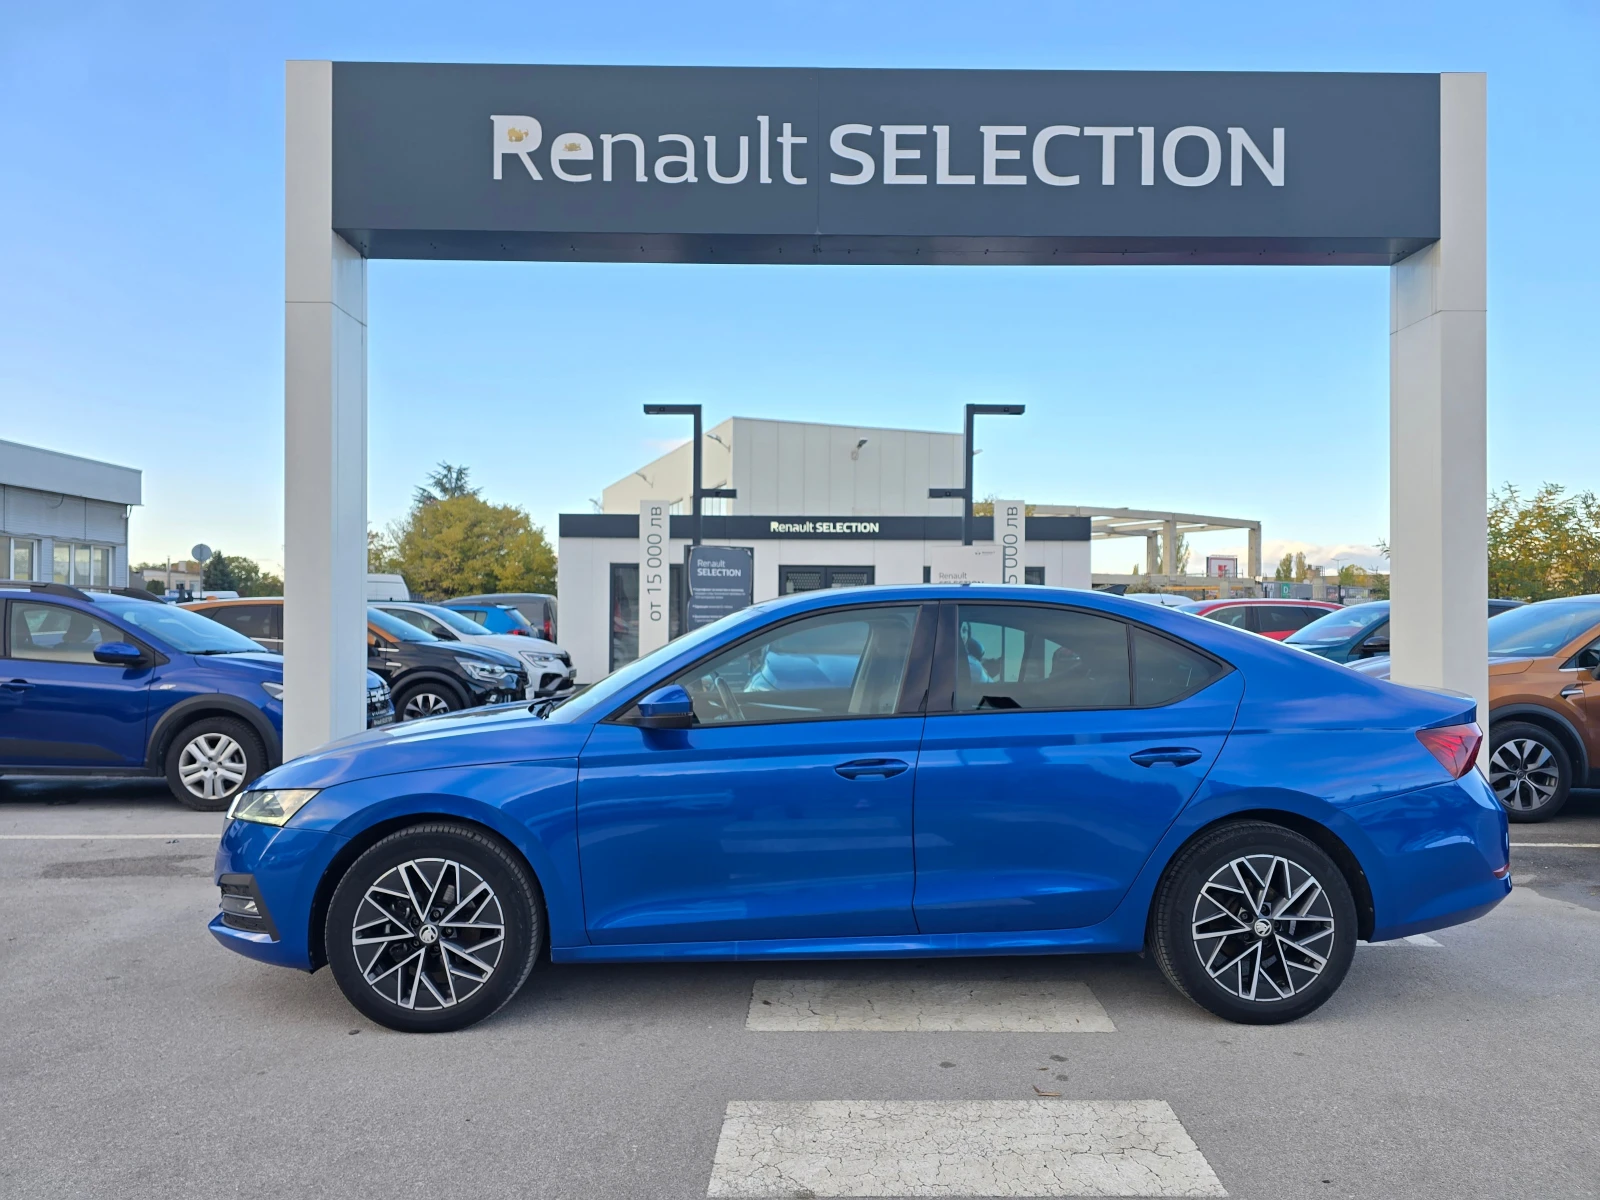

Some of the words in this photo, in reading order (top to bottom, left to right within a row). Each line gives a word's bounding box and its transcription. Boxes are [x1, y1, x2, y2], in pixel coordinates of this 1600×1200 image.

[490, 114, 807, 186] Renault
[829, 124, 1286, 188] SELECTION
[770, 521, 814, 532] Renault
[816, 522, 879, 533] SELECTION
[647, 534, 662, 568] 000
[697, 559, 725, 567] Renault
[697, 568, 741, 577] SELECTION
[939, 572, 967, 580] Renault
[647, 574, 662, 595] 15
